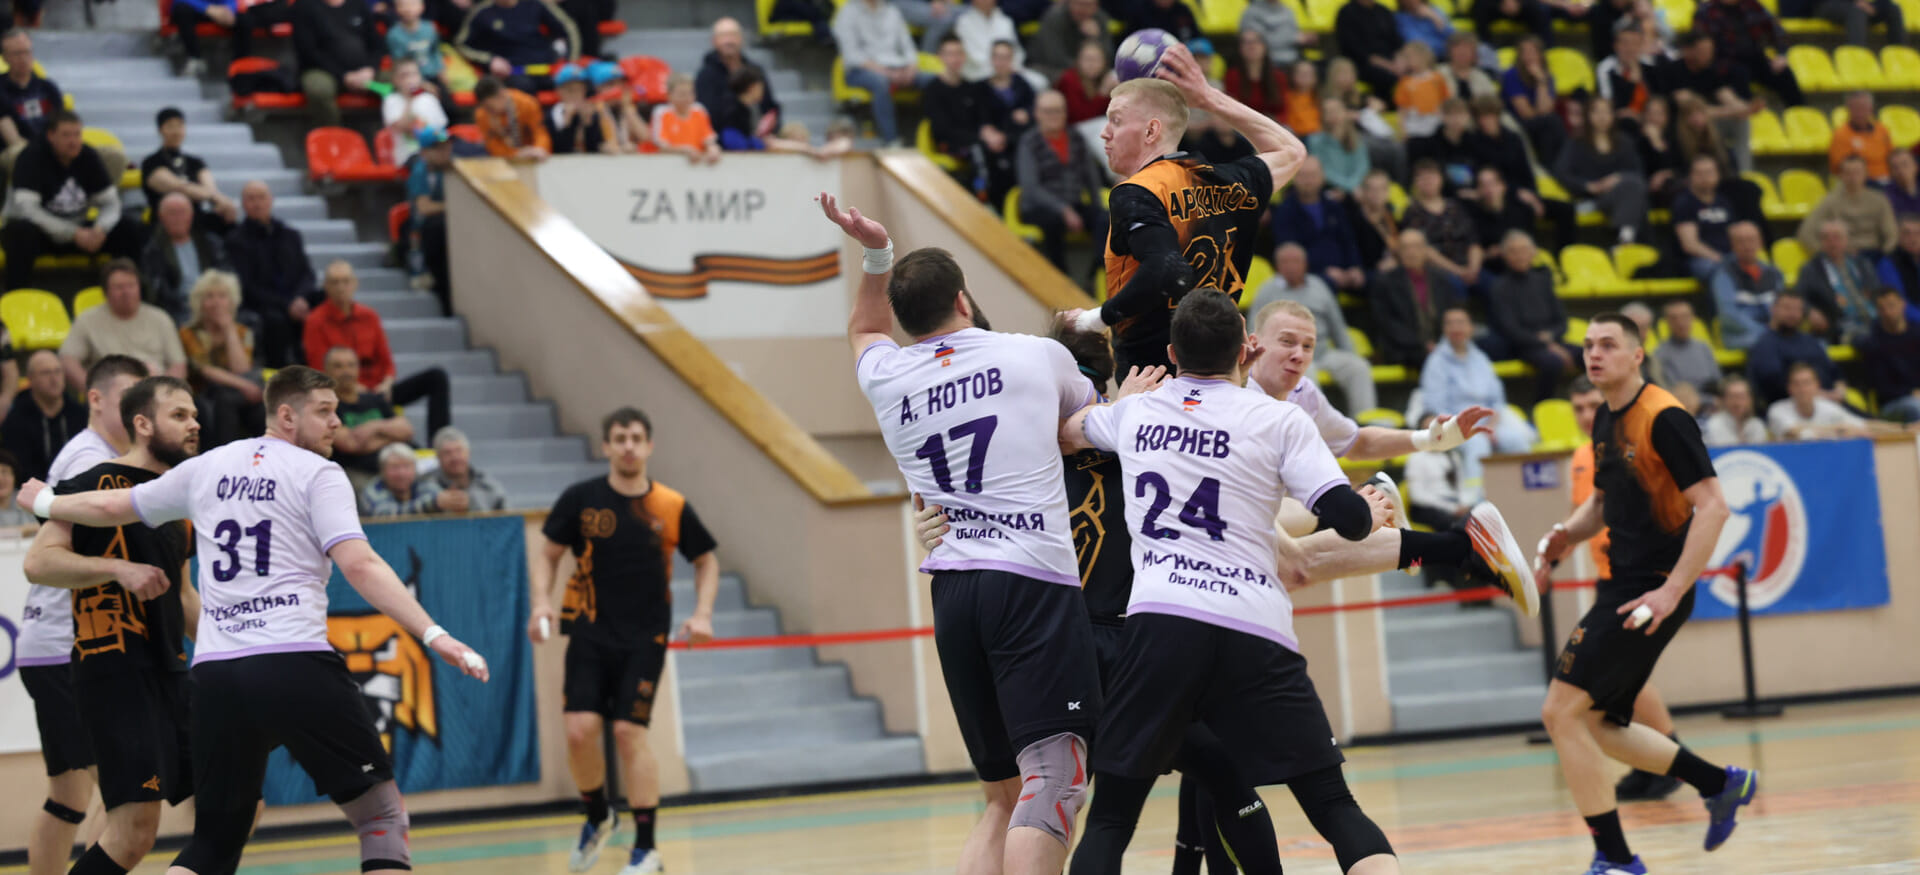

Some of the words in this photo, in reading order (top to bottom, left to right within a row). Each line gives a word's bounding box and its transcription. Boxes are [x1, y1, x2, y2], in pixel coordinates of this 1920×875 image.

[629, 189, 677, 223] ZA
[685, 189, 766, 222] МИР
[928, 367, 1004, 415] КОТОВ
[915, 415, 998, 494] 17
[1136, 424, 1230, 459] КОРНЕВ
[217, 475, 276, 503] ФУРЦЕВ
[1135, 471, 1228, 542] 24
[213, 519, 272, 582] 31
[1168, 572, 1239, 596] ОБЛАСТЬ
